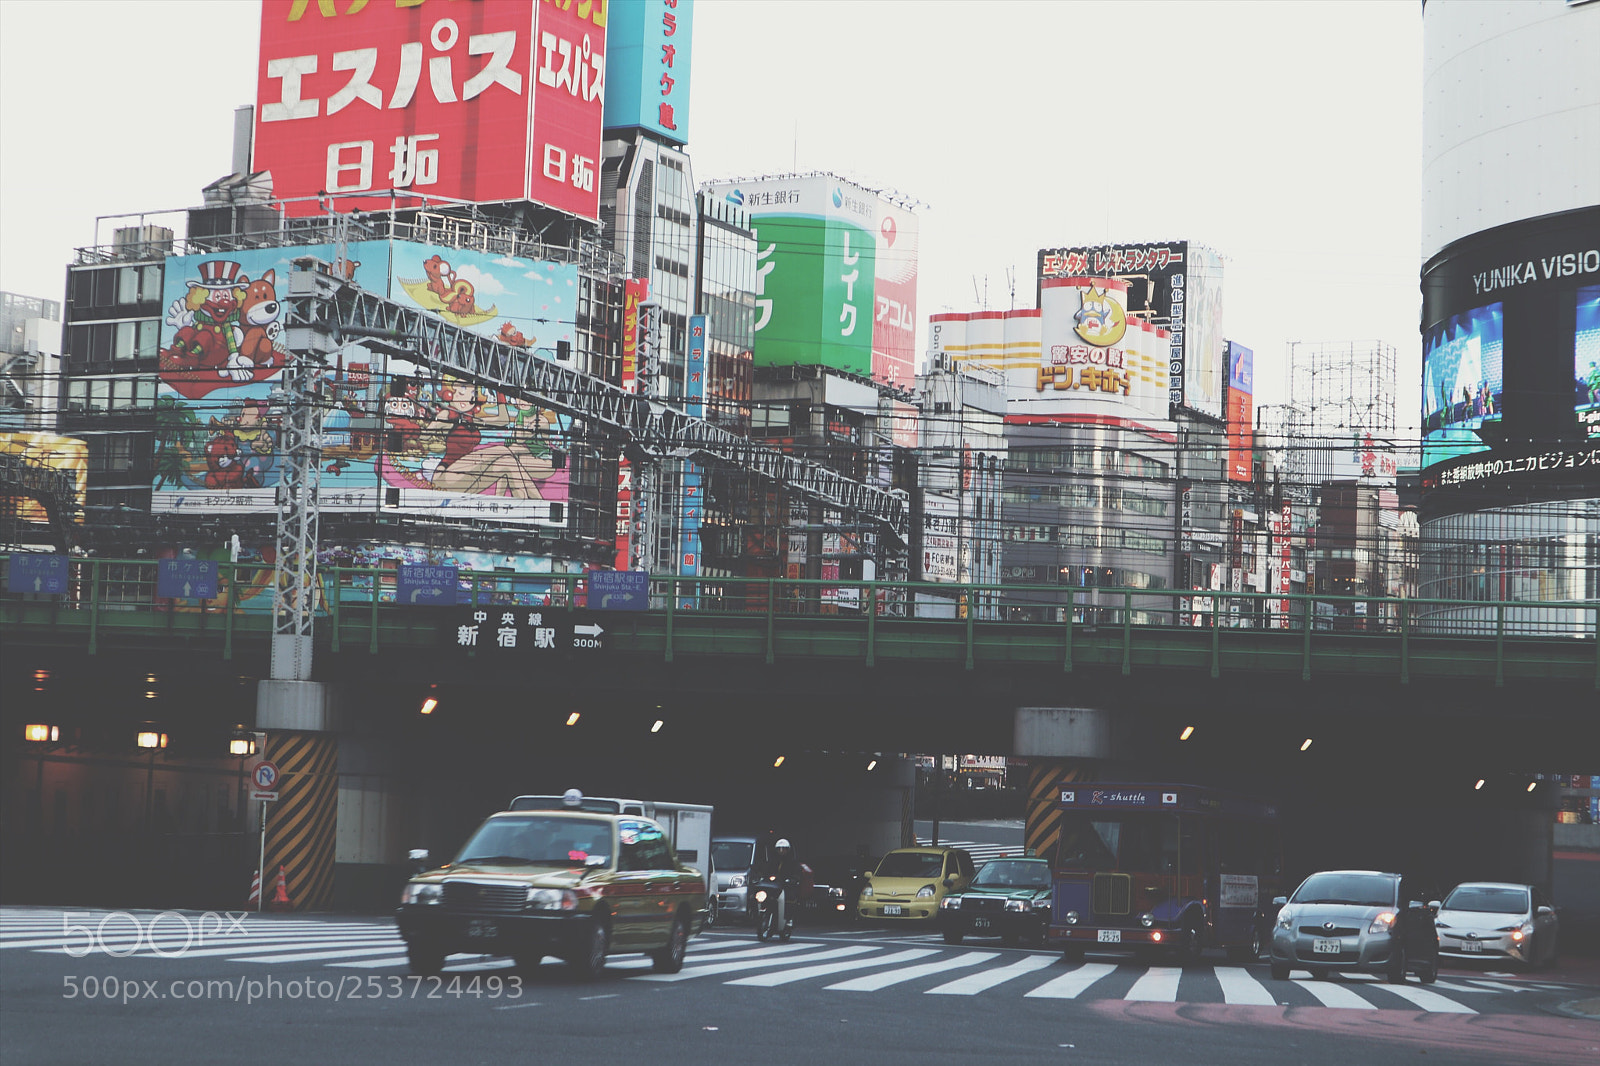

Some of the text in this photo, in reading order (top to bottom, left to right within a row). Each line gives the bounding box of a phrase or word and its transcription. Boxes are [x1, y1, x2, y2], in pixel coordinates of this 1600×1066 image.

[261, 18, 522, 122] エスパス
[538, 31, 603, 107] エスパス
[325, 133, 441, 193] 日拓
[543, 143, 595, 193] 日拓
[749, 190, 800, 206] 新生銀行
[844, 196, 872, 219] 新生銀行
[1043, 248, 1183, 274] エンタメ レストランタワー
[839, 231, 860, 337] レイク
[1473, 260, 1537, 295] YUNIKA
[876, 296, 914, 332] アコム
[933, 325, 942, 350] Don
[1169, 274, 1184, 404] 進化型居酒屋の聖地
[403, 577, 430, 586] Shinjuku
[594, 583, 620, 591] Shinjuku
[473, 610, 543, 626] 中央線
[457, 625, 556, 649] 新宿駅
[573, 638, 602, 649] 300M
[1319, 944, 1339, 952] 42-77
